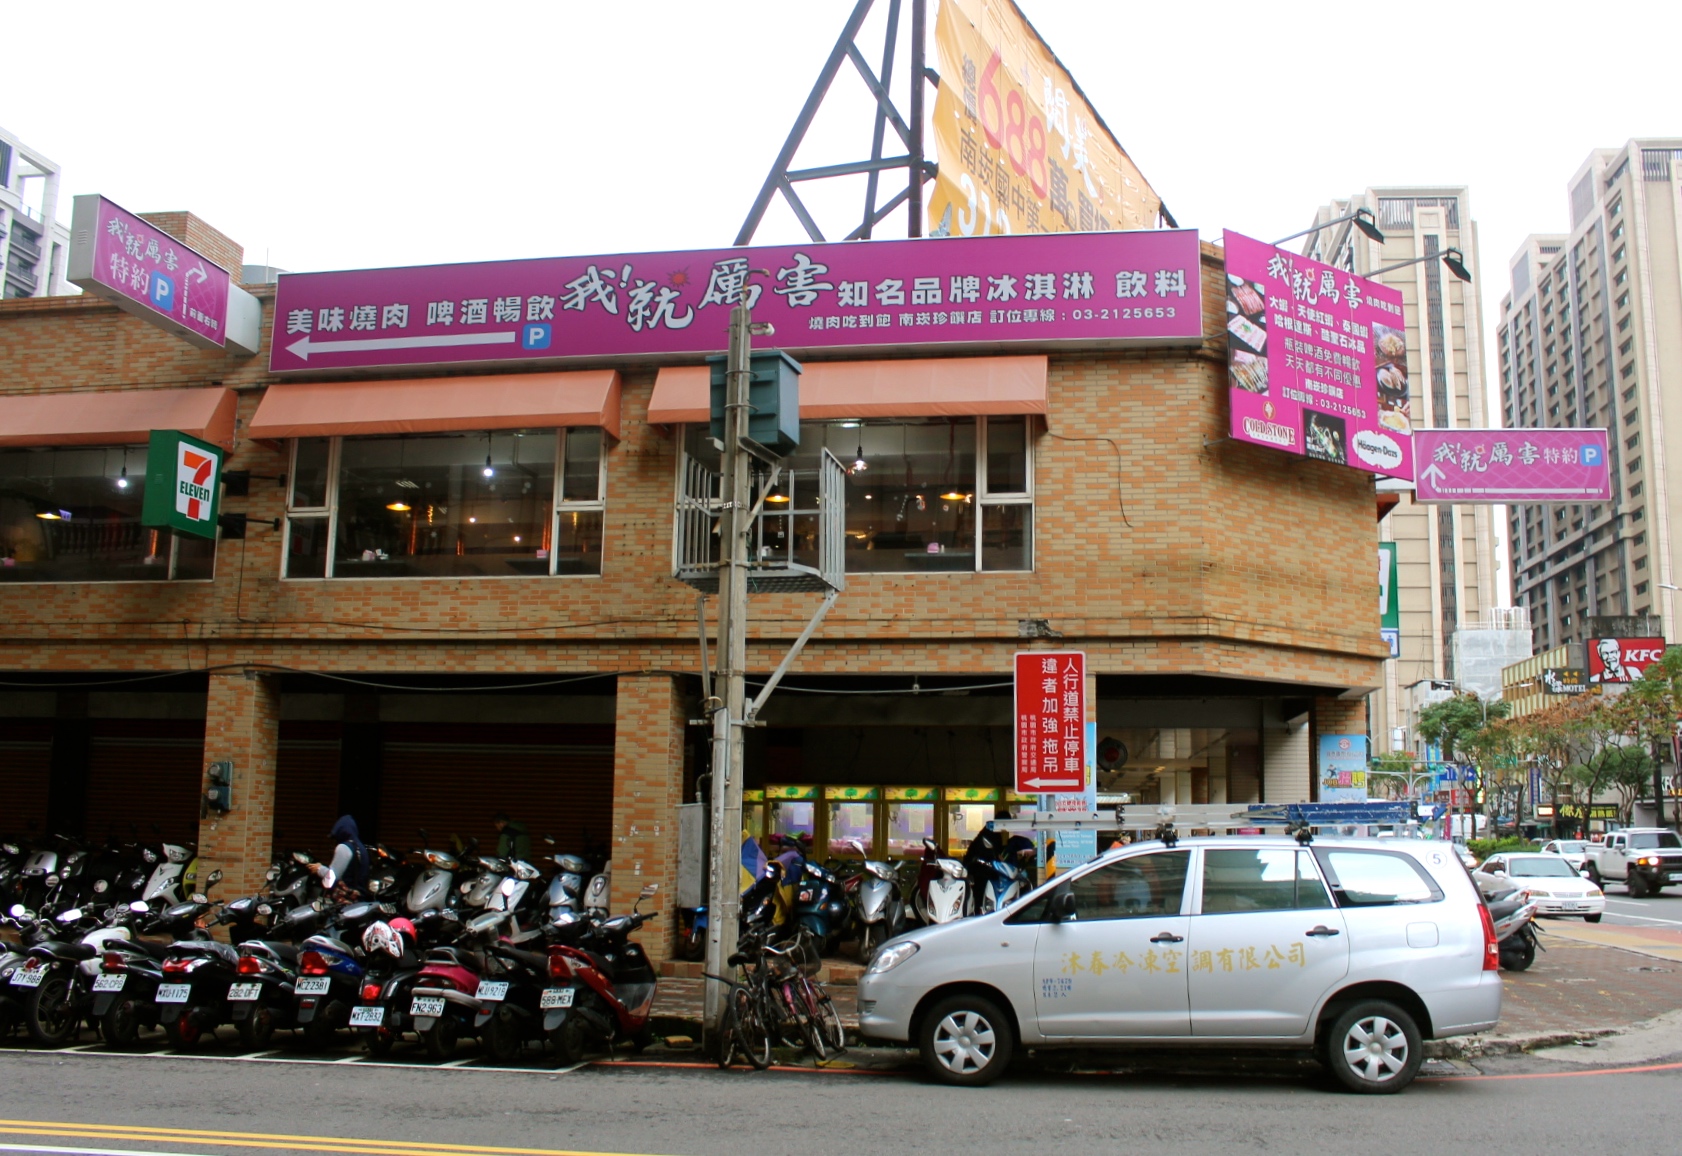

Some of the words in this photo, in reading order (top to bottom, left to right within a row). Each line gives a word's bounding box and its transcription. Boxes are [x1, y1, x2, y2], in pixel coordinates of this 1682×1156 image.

[978, 43, 1048, 200] 688
[110, 253, 150, 295] 特約
[155, 278, 170, 302] P
[286, 303, 410, 335] 美味燒肉
[426, 295, 556, 327] 啤酒暢飲
[837, 271, 1095, 307] 知名品牌冰淇淋
[1115, 268, 1187, 299] 飲料
[809, 314, 891, 330] 燒肉吃到飽
[528, 328, 545, 345] P
[1243, 416, 1266, 434] COLD
[1267, 422, 1295, 444] STONE
[1543, 447, 1578, 465] 特約
[1585, 448, 1598, 463] P
[1624, 649, 1662, 662] KFC
[1042, 658, 1058, 773] 違者加強拖吊
[1063, 658, 1080, 773] 人行道禁止停車
[1433, 854, 1442, 865] 5
